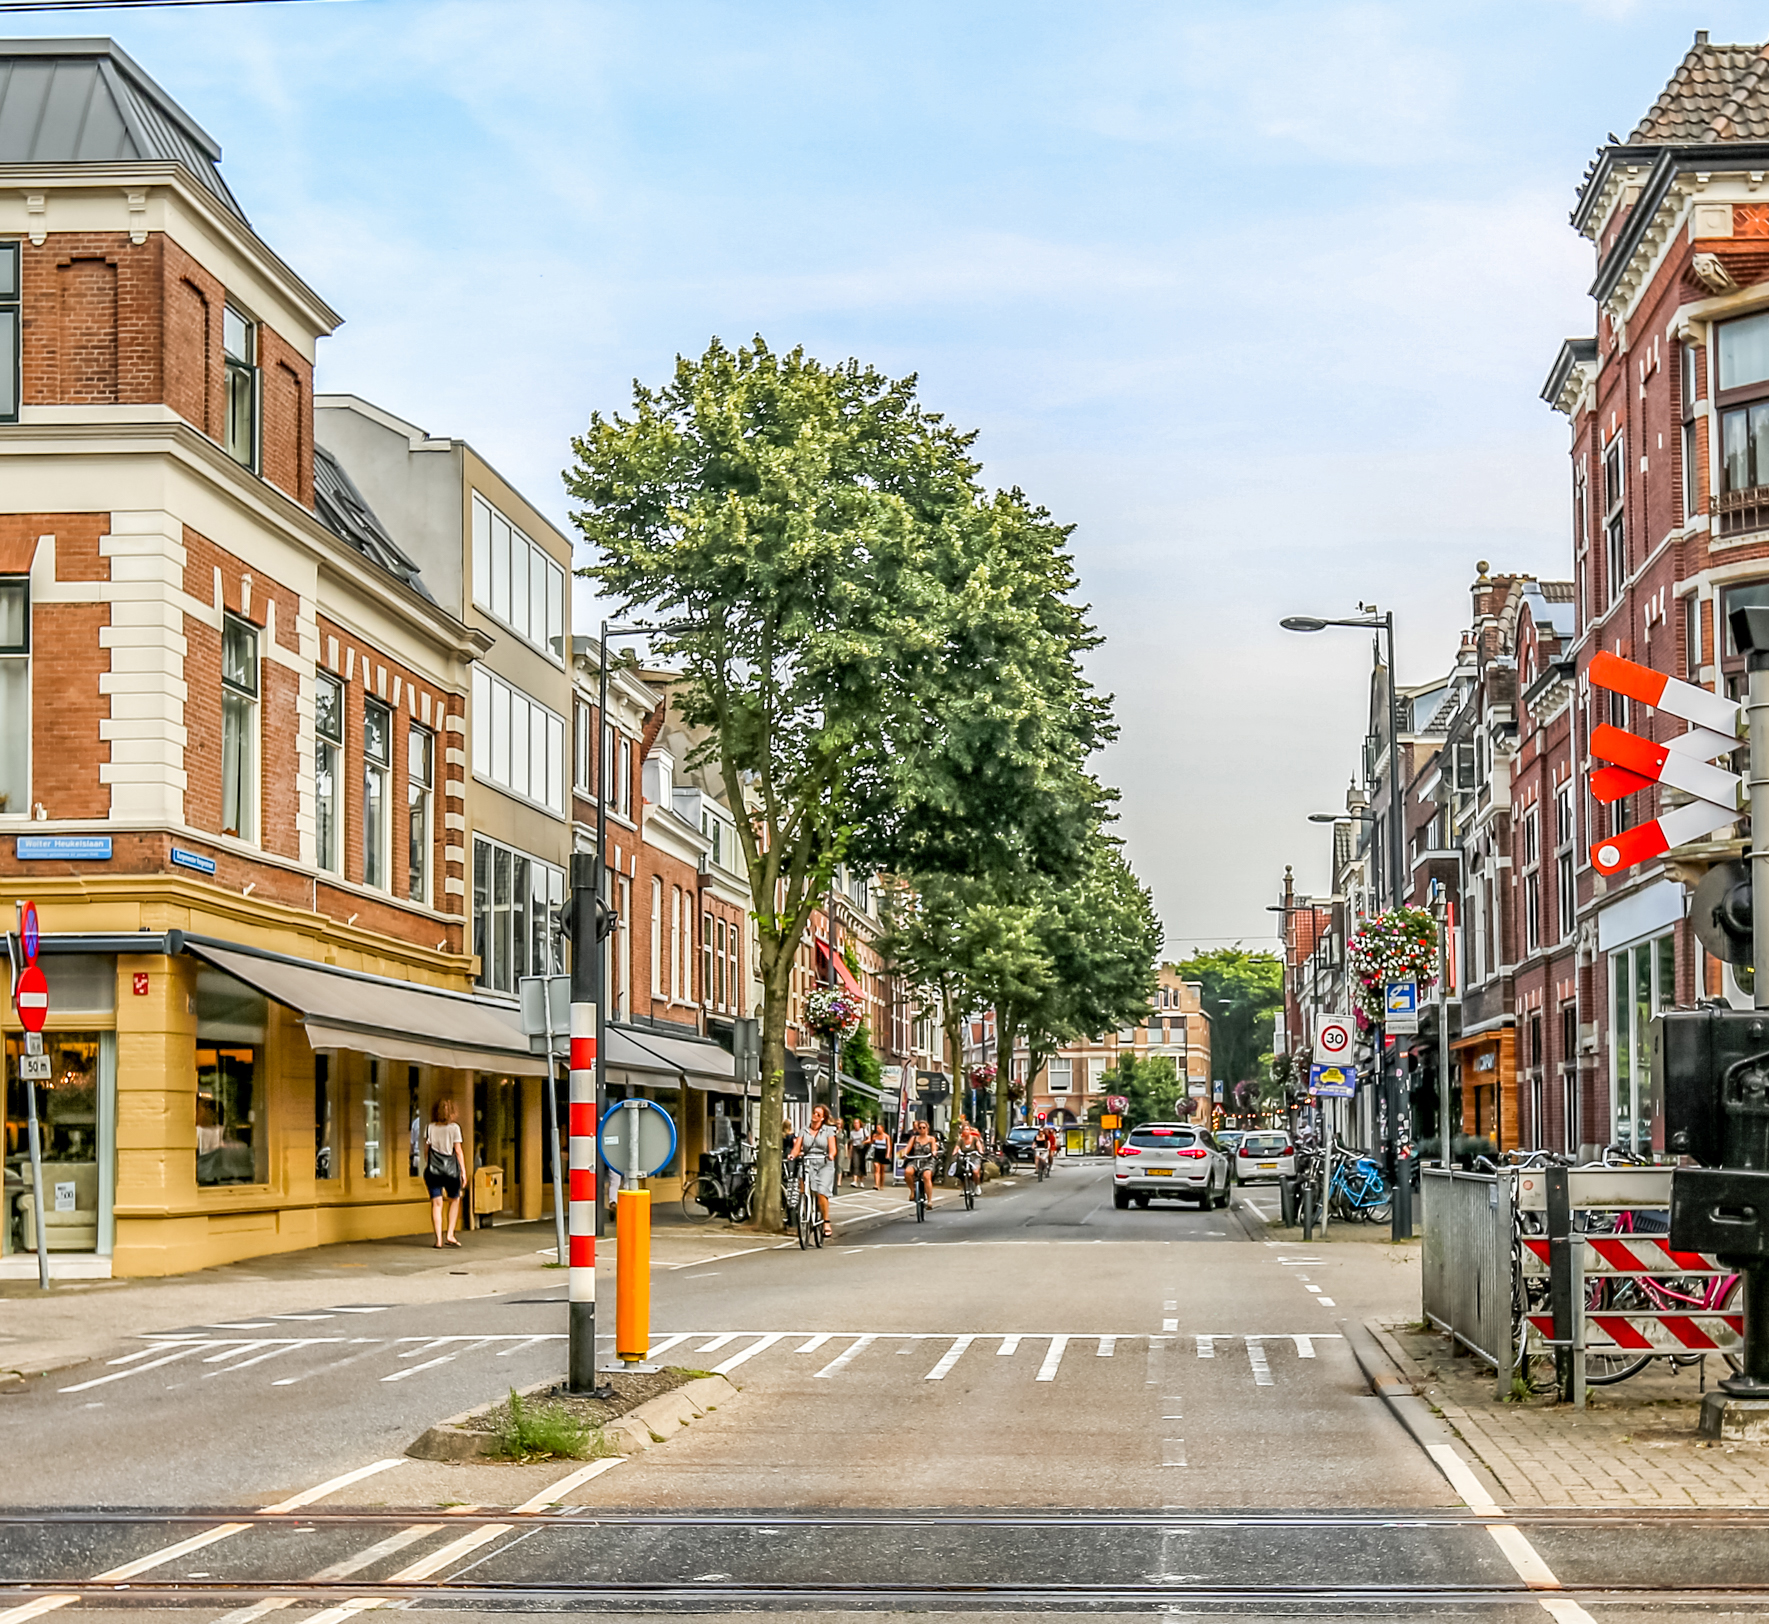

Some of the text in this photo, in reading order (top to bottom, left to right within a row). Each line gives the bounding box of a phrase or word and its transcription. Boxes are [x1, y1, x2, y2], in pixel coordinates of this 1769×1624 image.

[54, 839, 104, 848] Heukelslaan
[1326, 1032, 1344, 1044] 30
[28, 1061, 48, 1073] 50 m
